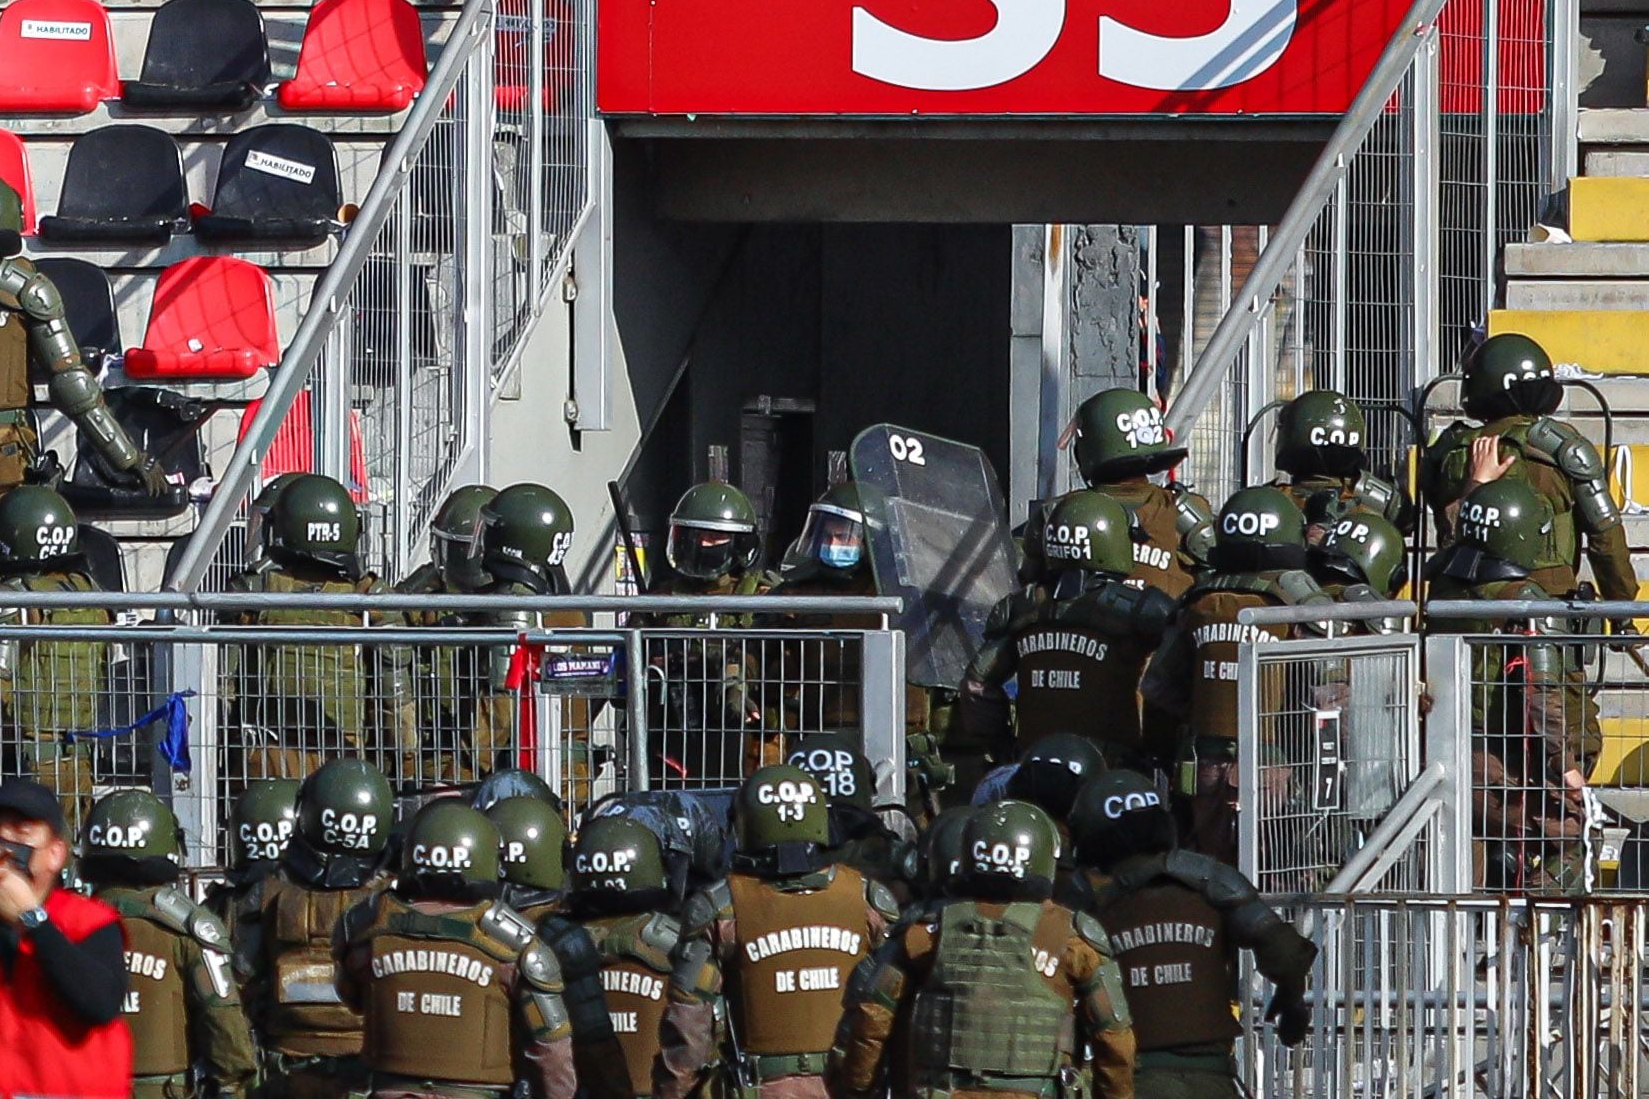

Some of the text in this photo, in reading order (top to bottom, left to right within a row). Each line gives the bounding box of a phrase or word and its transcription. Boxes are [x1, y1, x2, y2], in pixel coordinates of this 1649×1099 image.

[36, 24, 88, 36] HABILITADO
[260, 157, 313, 181] HABILITADO
[888, 434, 926, 467] 02
[1224, 512, 1280, 537] COP
[1032, 670, 1082, 690] DE CHILE
[758, 781, 817, 805] C.O.P.
[322, 808, 378, 835] C.O.P.
[89, 825, 147, 848] C.O.P.
[413, 844, 472, 869] C.O.P.
[746, 925, 861, 963] CARABINEROS
[1112, 922, 1217, 956] ARABINEROS
[371, 949, 493, 988] CARABINEROS
[775, 967, 841, 994] DE CHILE
[1132, 962, 1193, 987] DE CHILE
[396, 992, 463, 1017] DE CHILE
